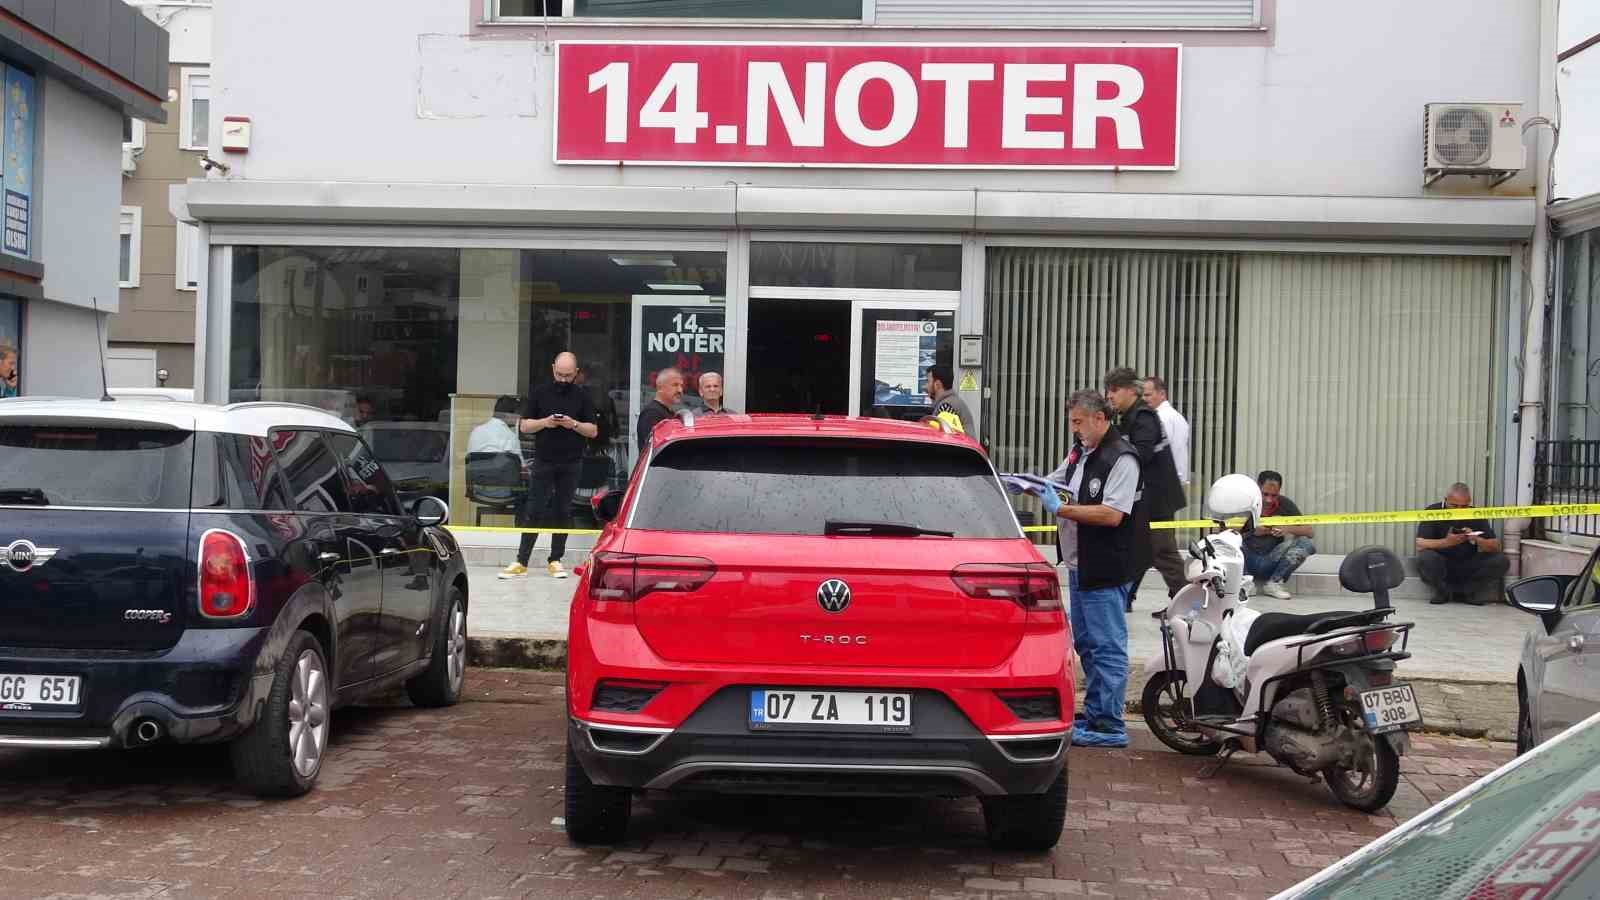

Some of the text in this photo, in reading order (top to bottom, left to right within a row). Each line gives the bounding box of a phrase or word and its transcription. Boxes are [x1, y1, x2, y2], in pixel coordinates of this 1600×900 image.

[587, 61, 1144, 150] 14.NOTER
[672, 313, 704, 333] 14.
[648, 332, 724, 352] NOTER
[8, 551, 32, 561] MINI
[800, 635, 867, 645] T-ROC
[1, 676, 76, 702] GG 651
[767, 693, 906, 722] 07 ZA 119
[1364, 691, 1380, 708] 07
[753, 708, 763, 717] TR
[1381, 706, 1407, 722] 308
